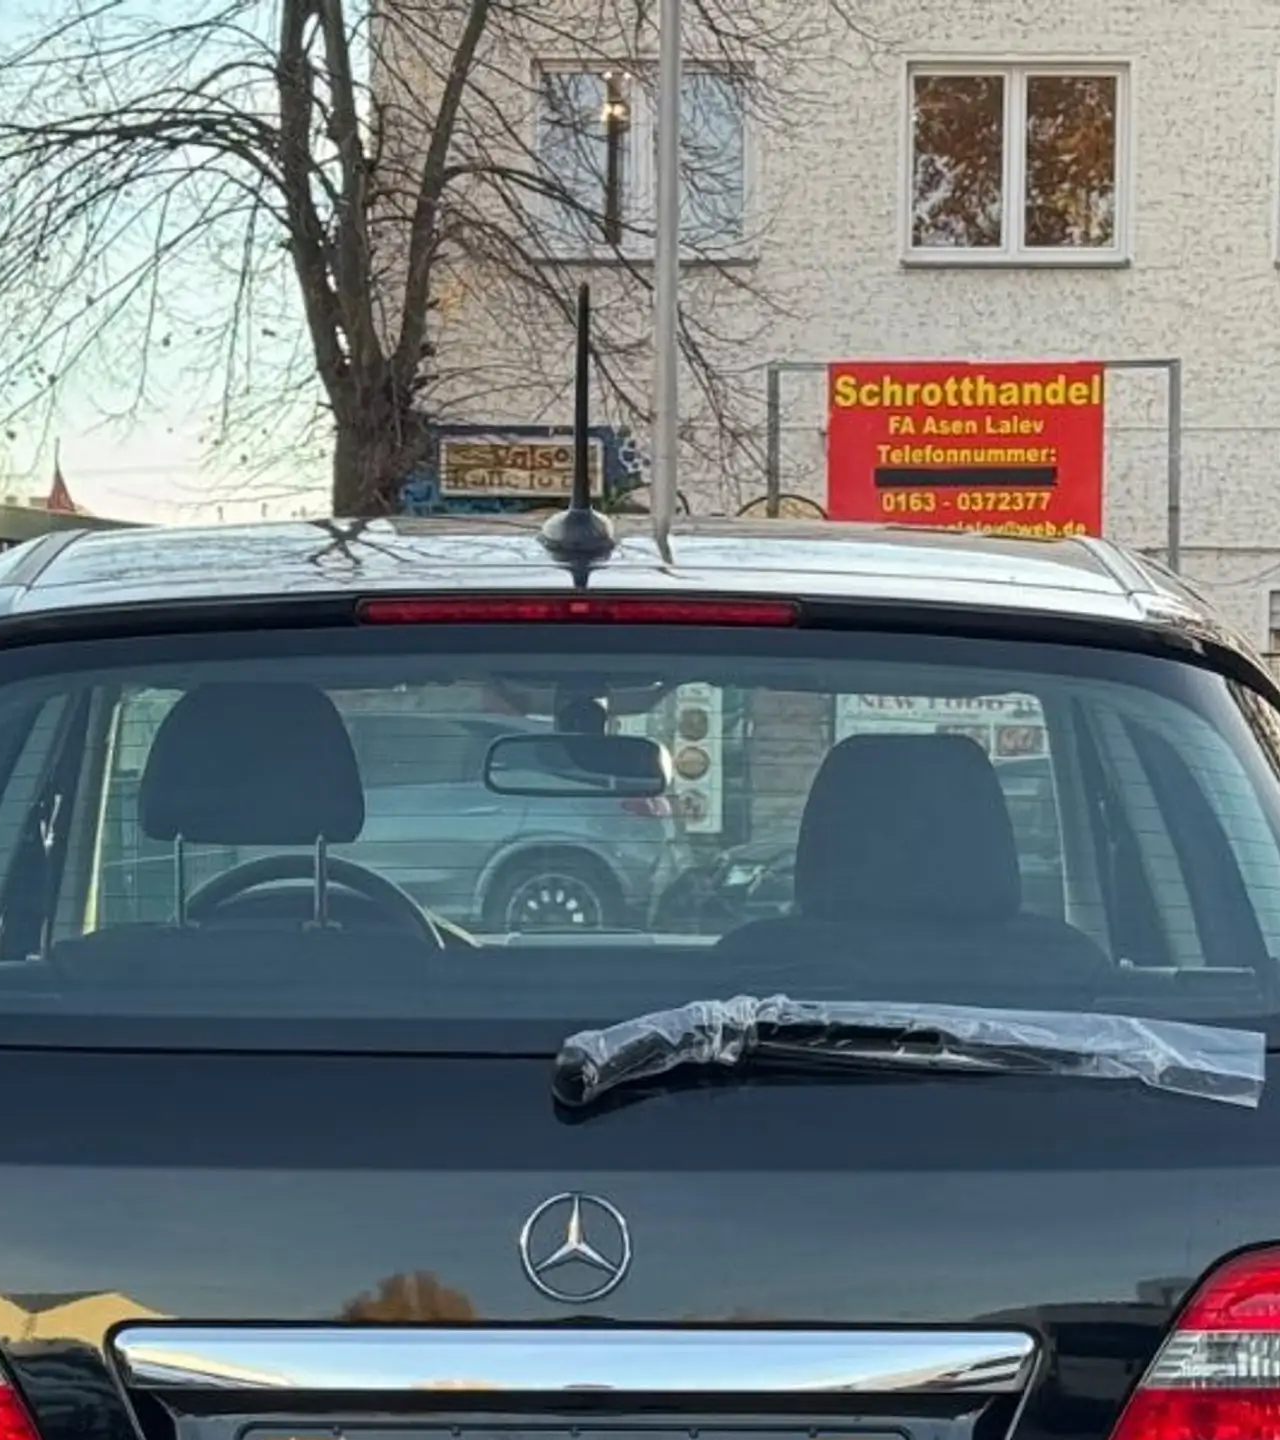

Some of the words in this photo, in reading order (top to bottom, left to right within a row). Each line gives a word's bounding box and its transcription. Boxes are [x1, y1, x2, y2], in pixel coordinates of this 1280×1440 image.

[834, 374, 1101, 408] Schrotthandel
[888, 416, 916, 435] FA
[923, 416, 977, 435] Asen
[876, 444, 1058, 464] Telefonnummer:
[881, 492, 937, 512] 0163
[956, 492, 1053, 512] 0372377
